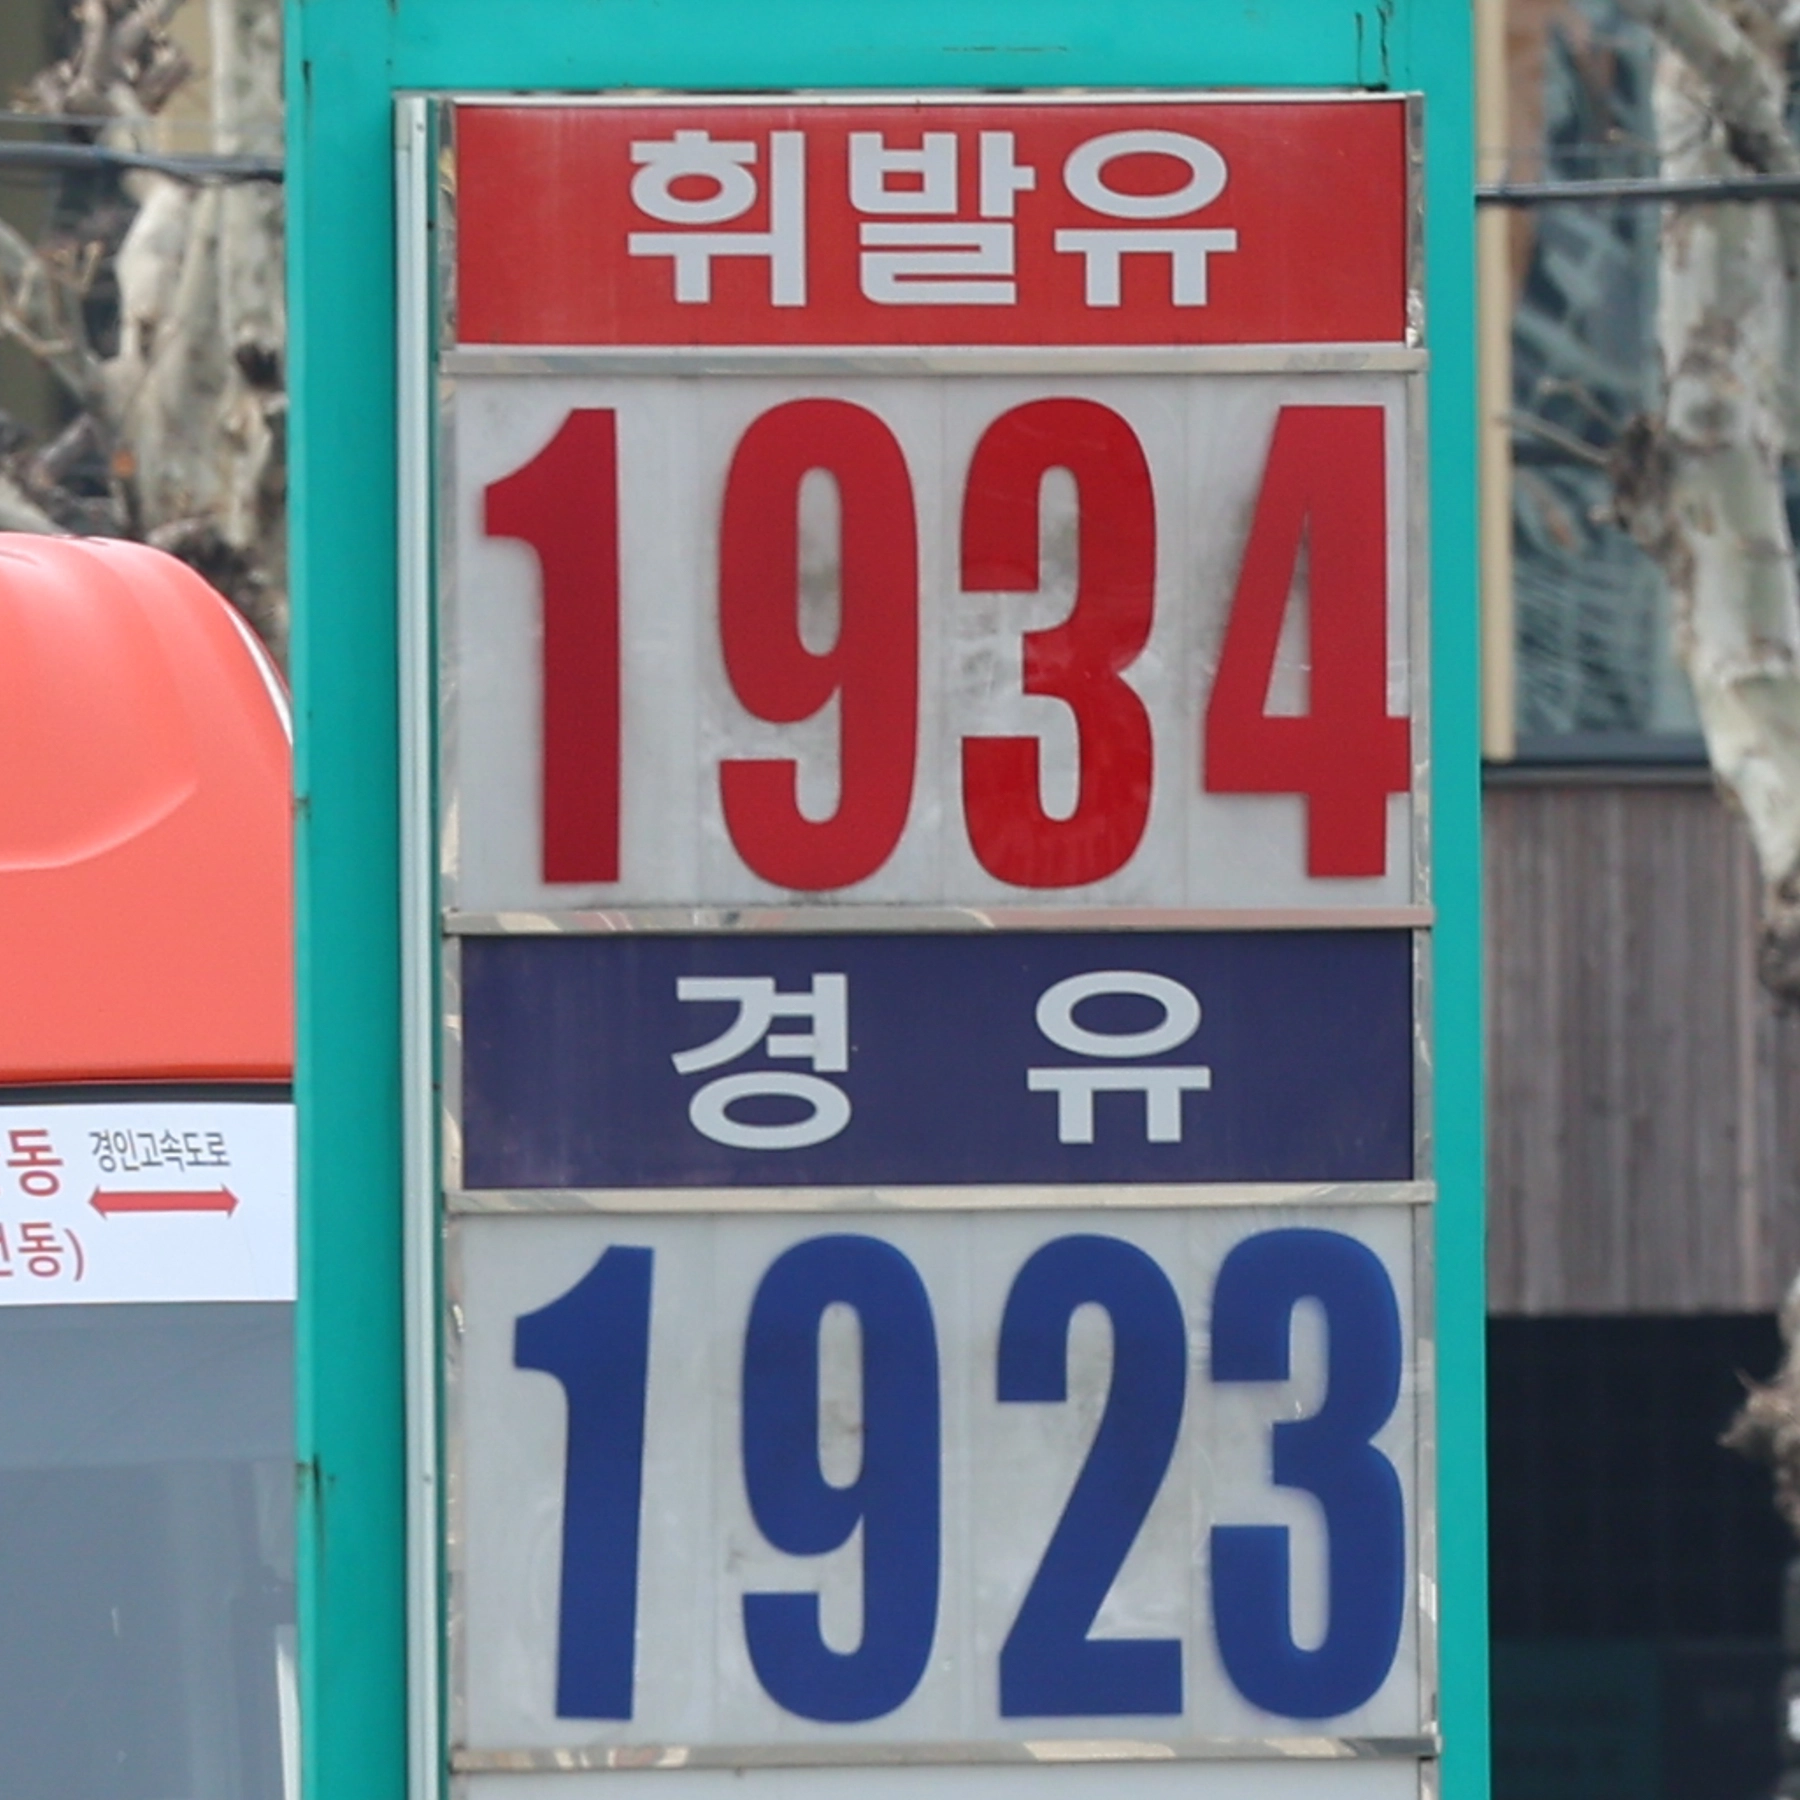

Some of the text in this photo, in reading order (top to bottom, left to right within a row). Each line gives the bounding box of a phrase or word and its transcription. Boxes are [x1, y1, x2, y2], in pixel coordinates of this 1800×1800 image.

[627, 130, 1237, 306] 휘발유
[482, 396, 1412, 892] 1934
[89, 1129, 231, 1174] 경인고속도로
[513, 1228, 1406, 1724] 1923
